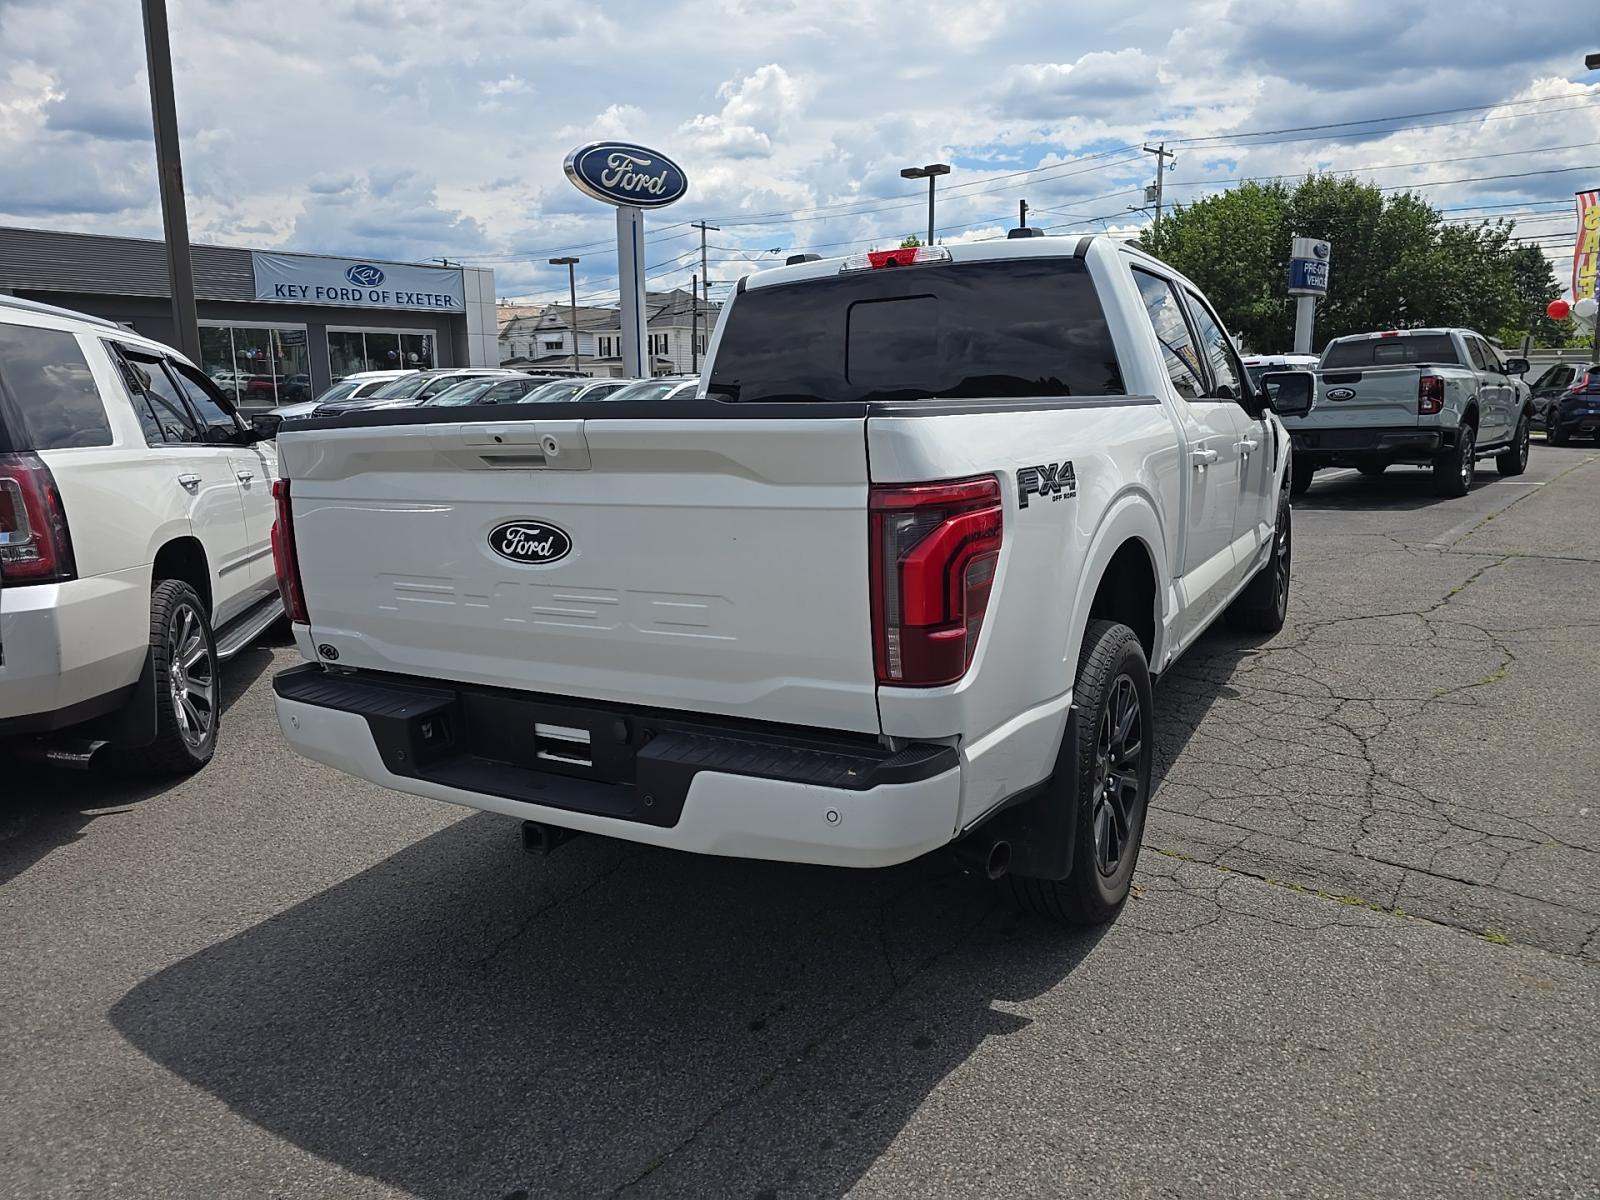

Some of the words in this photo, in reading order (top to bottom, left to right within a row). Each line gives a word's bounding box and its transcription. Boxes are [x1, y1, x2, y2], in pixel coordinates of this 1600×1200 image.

[601, 152, 667, 195] Ford
[348, 265, 381, 286] Key
[274, 283, 309, 298] KEY
[315, 286, 363, 301] FORD
[368, 289, 390, 303] OF
[395, 291, 454, 307] EXETER
[1016, 460, 1076, 510] FX4
[501, 526, 555, 556] Ford
